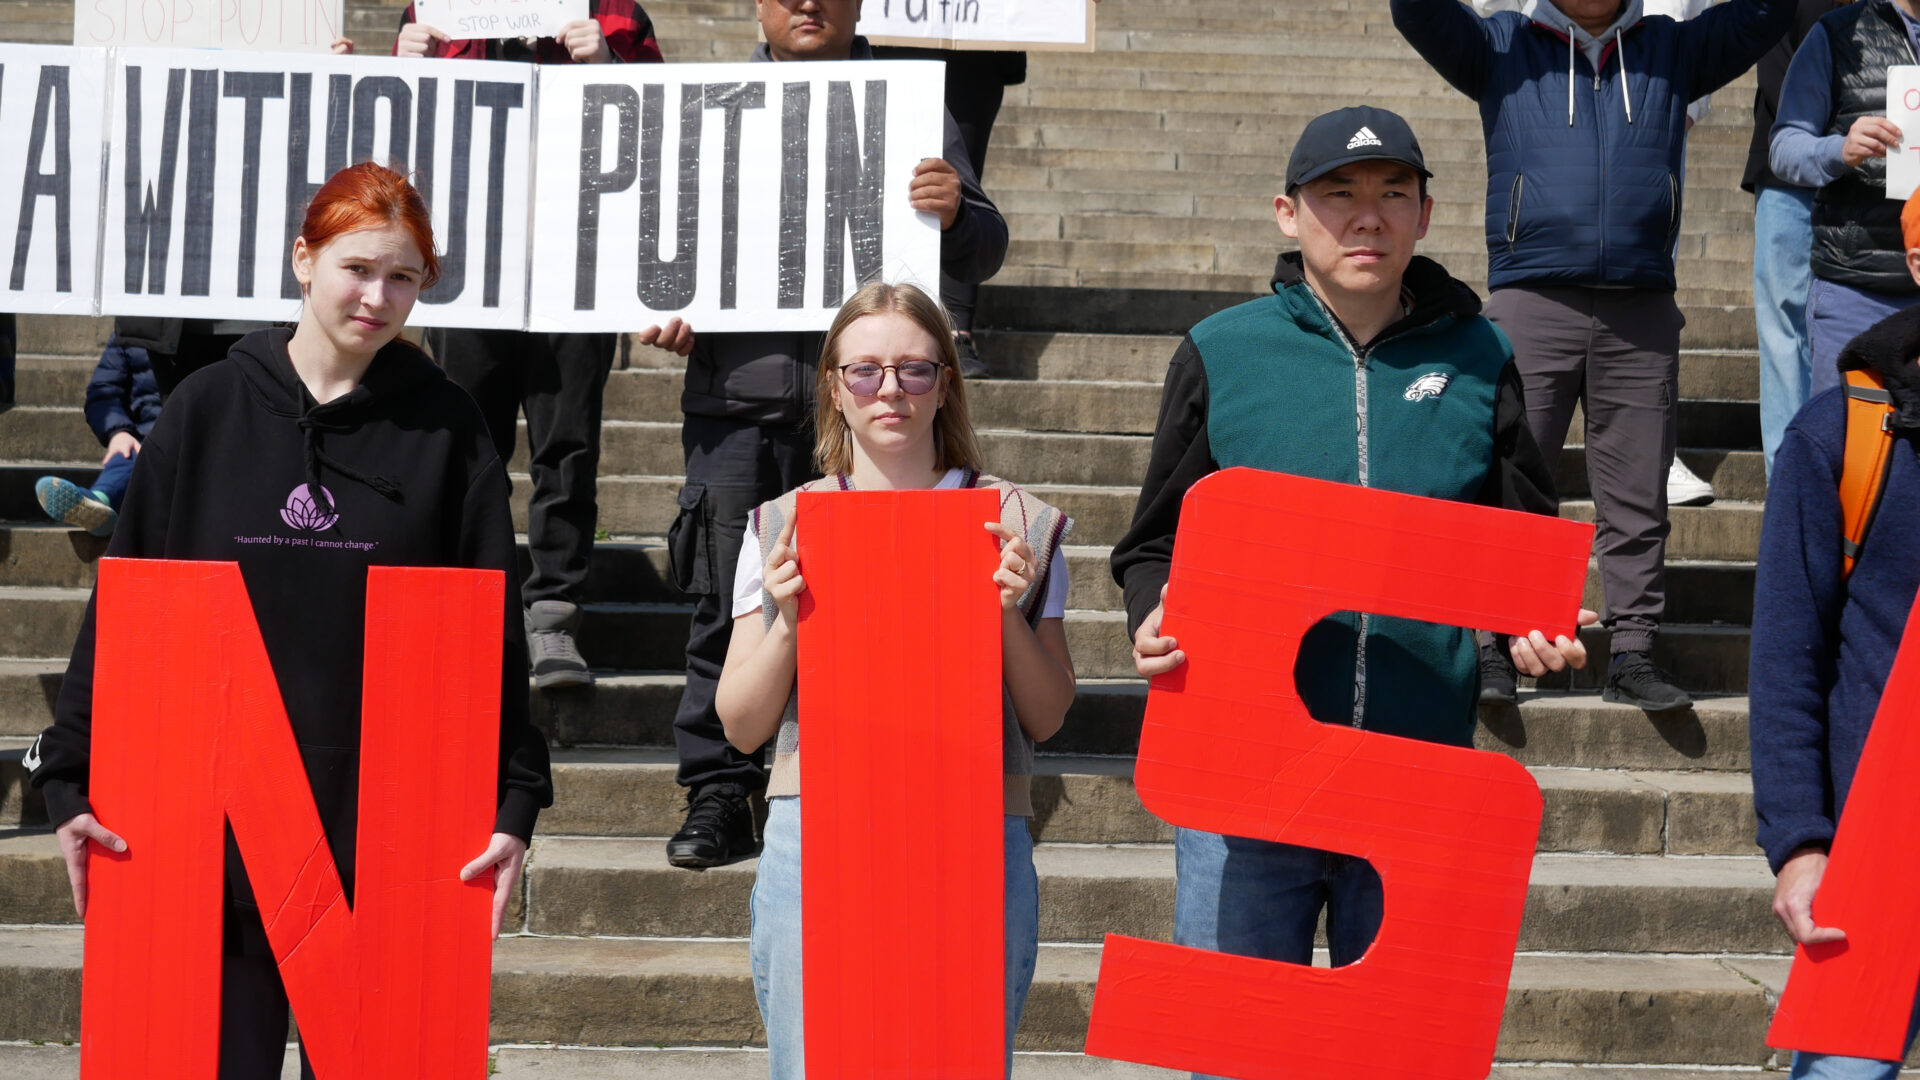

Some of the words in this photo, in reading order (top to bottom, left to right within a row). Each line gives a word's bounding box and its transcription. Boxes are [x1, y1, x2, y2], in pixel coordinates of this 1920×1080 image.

[458, 14, 499, 32] STOP
[1346, 138, 1383, 150] adidas
[124, 65, 524, 308] WITHOUT
[573, 79, 888, 312] PUTIN
[273, 536, 283, 545] by
[291, 538, 308, 547] past
[315, 540, 343, 548] cannot
